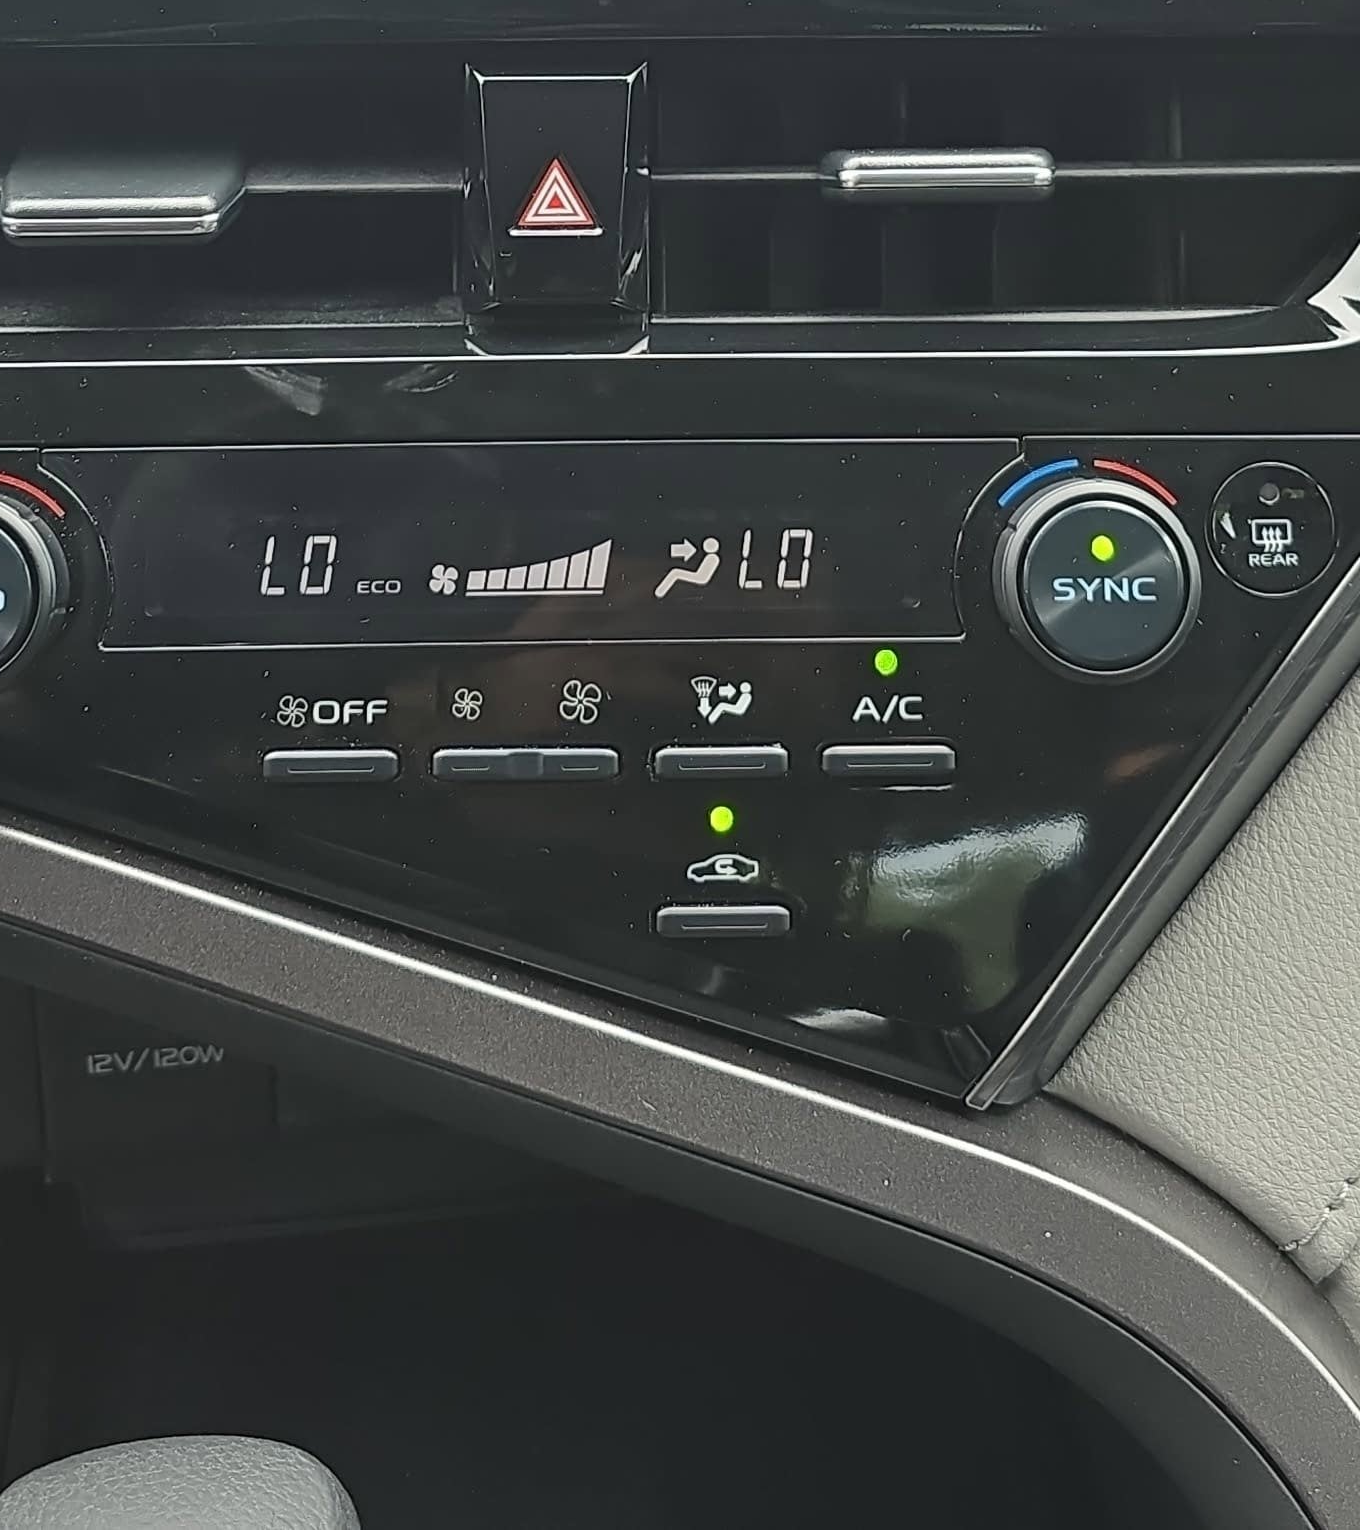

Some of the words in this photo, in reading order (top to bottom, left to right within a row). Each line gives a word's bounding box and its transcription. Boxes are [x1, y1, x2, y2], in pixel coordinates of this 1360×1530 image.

[1248, 552, 1299, 568] REAR
[356, 580, 401, 595] ECO
[1053, 577, 1157, 603] SYNC
[312, 699, 388, 725] OFF
[852, 695, 923, 723] A/C
[87, 1046, 224, 1073] 12V/120W
